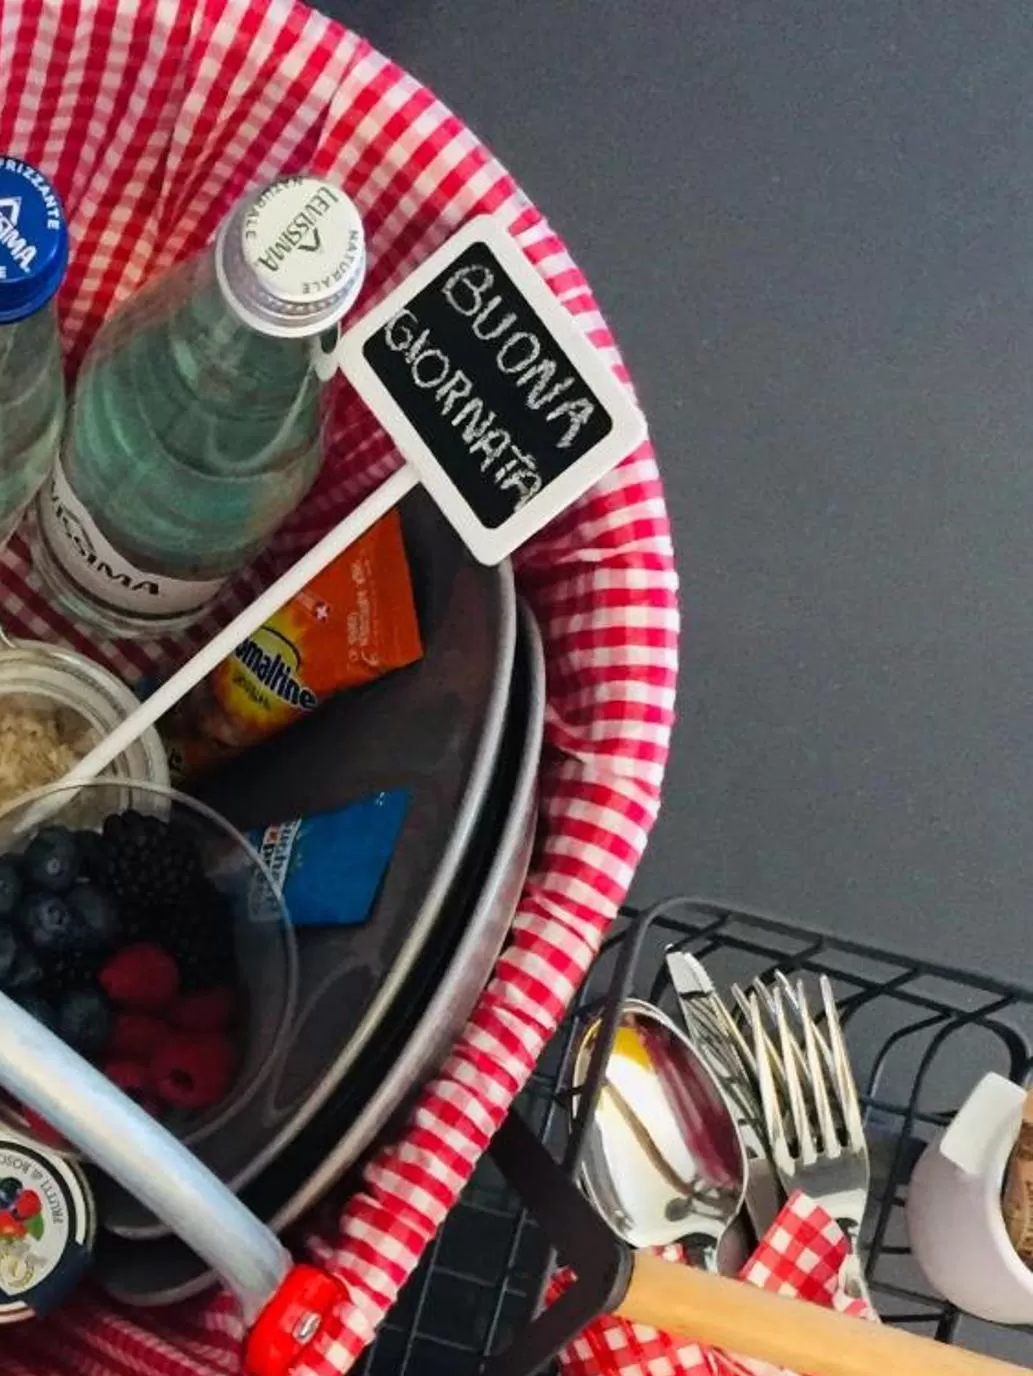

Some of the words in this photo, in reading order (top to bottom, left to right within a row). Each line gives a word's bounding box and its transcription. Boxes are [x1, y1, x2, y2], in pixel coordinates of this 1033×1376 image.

[257, 185, 340, 273] LEVISSIMA
[301, 229, 360, 295] NATURALE
[384, 308, 543, 515] GIORNATA
[441, 263, 596, 449] BUONA
